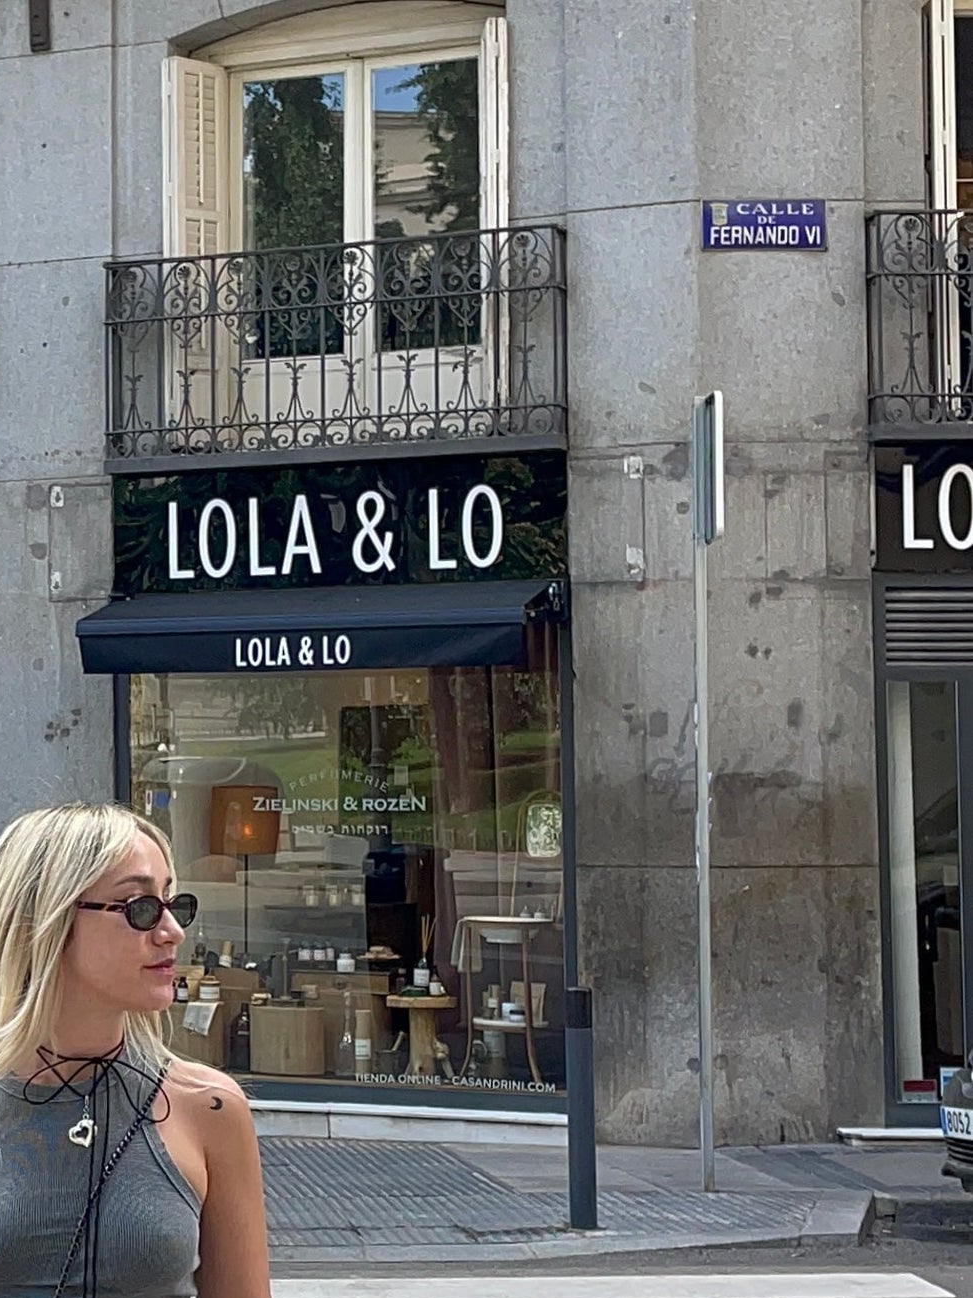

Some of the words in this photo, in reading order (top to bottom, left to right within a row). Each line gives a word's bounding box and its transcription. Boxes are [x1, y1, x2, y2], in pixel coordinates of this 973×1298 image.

[736, 203, 815, 215] CALLE
[757, 215, 777, 225] DE
[710, 225, 800, 245] FERNANDO
[804, 225, 821, 245] VI
[168, 494, 323, 579] LOLA
[352, 490, 396, 573] &
[428, 484, 503, 570] LO
[235, 636, 291, 667] LOLA
[298, 635, 315, 665] &
[322, 634, 351, 665] LO
[288, 768, 390, 793] PERFUMERIE
[342, 796, 358, 812] &
[355, 1073, 396, 1084] TIENDA
[397, 1073, 441, 1086] ONLINE
[452, 1075, 556, 1093] CASANDRINI.COM
[947, 1110, 972, 1136] 8052
